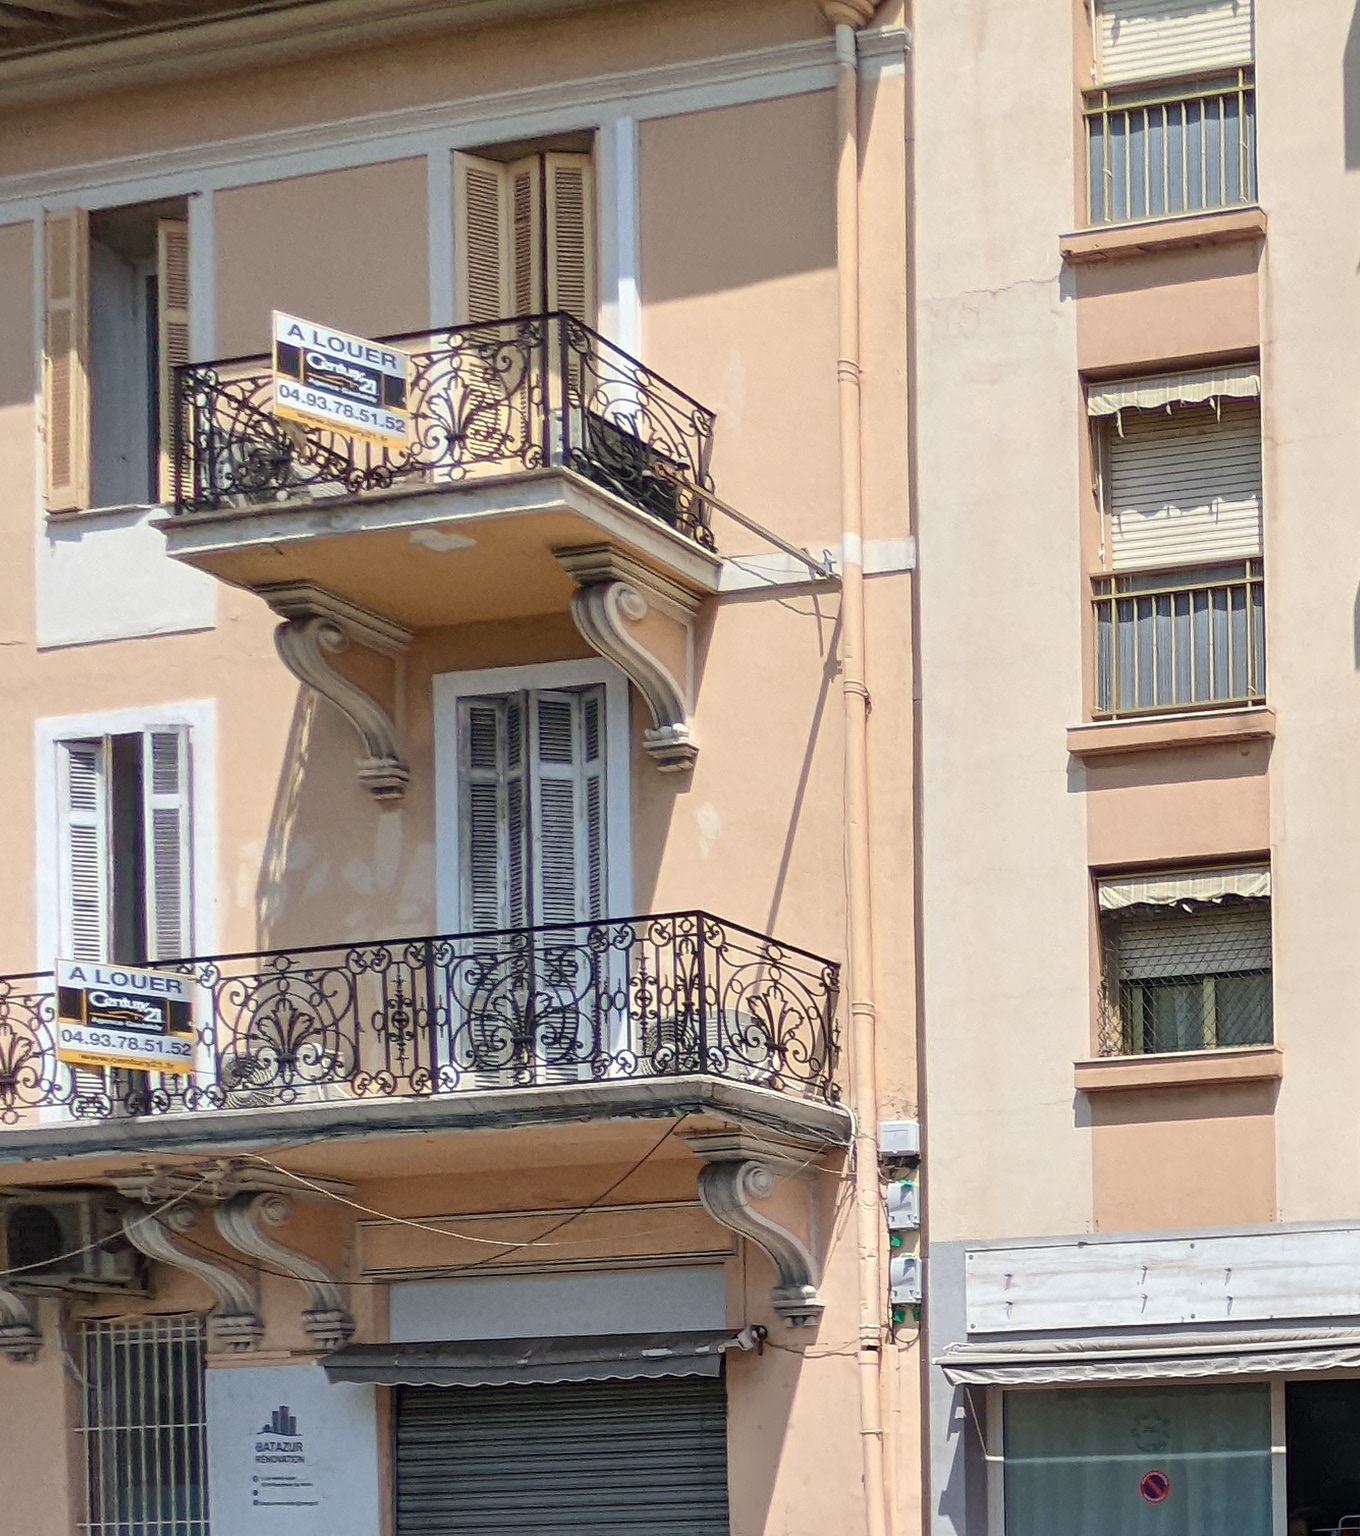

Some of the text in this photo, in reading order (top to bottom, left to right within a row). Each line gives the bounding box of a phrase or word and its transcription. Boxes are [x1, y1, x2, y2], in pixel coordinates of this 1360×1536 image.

[287, 323, 397, 369] A LOUER
[279, 384, 406, 433] 04.93.78.51.52
[69, 966, 183, 994] A LOUER
[89, 991, 150, 1011] Century
[143, 1007, 162, 1023] 21
[61, 1029, 192, 1057] 04.93.78.51.52
